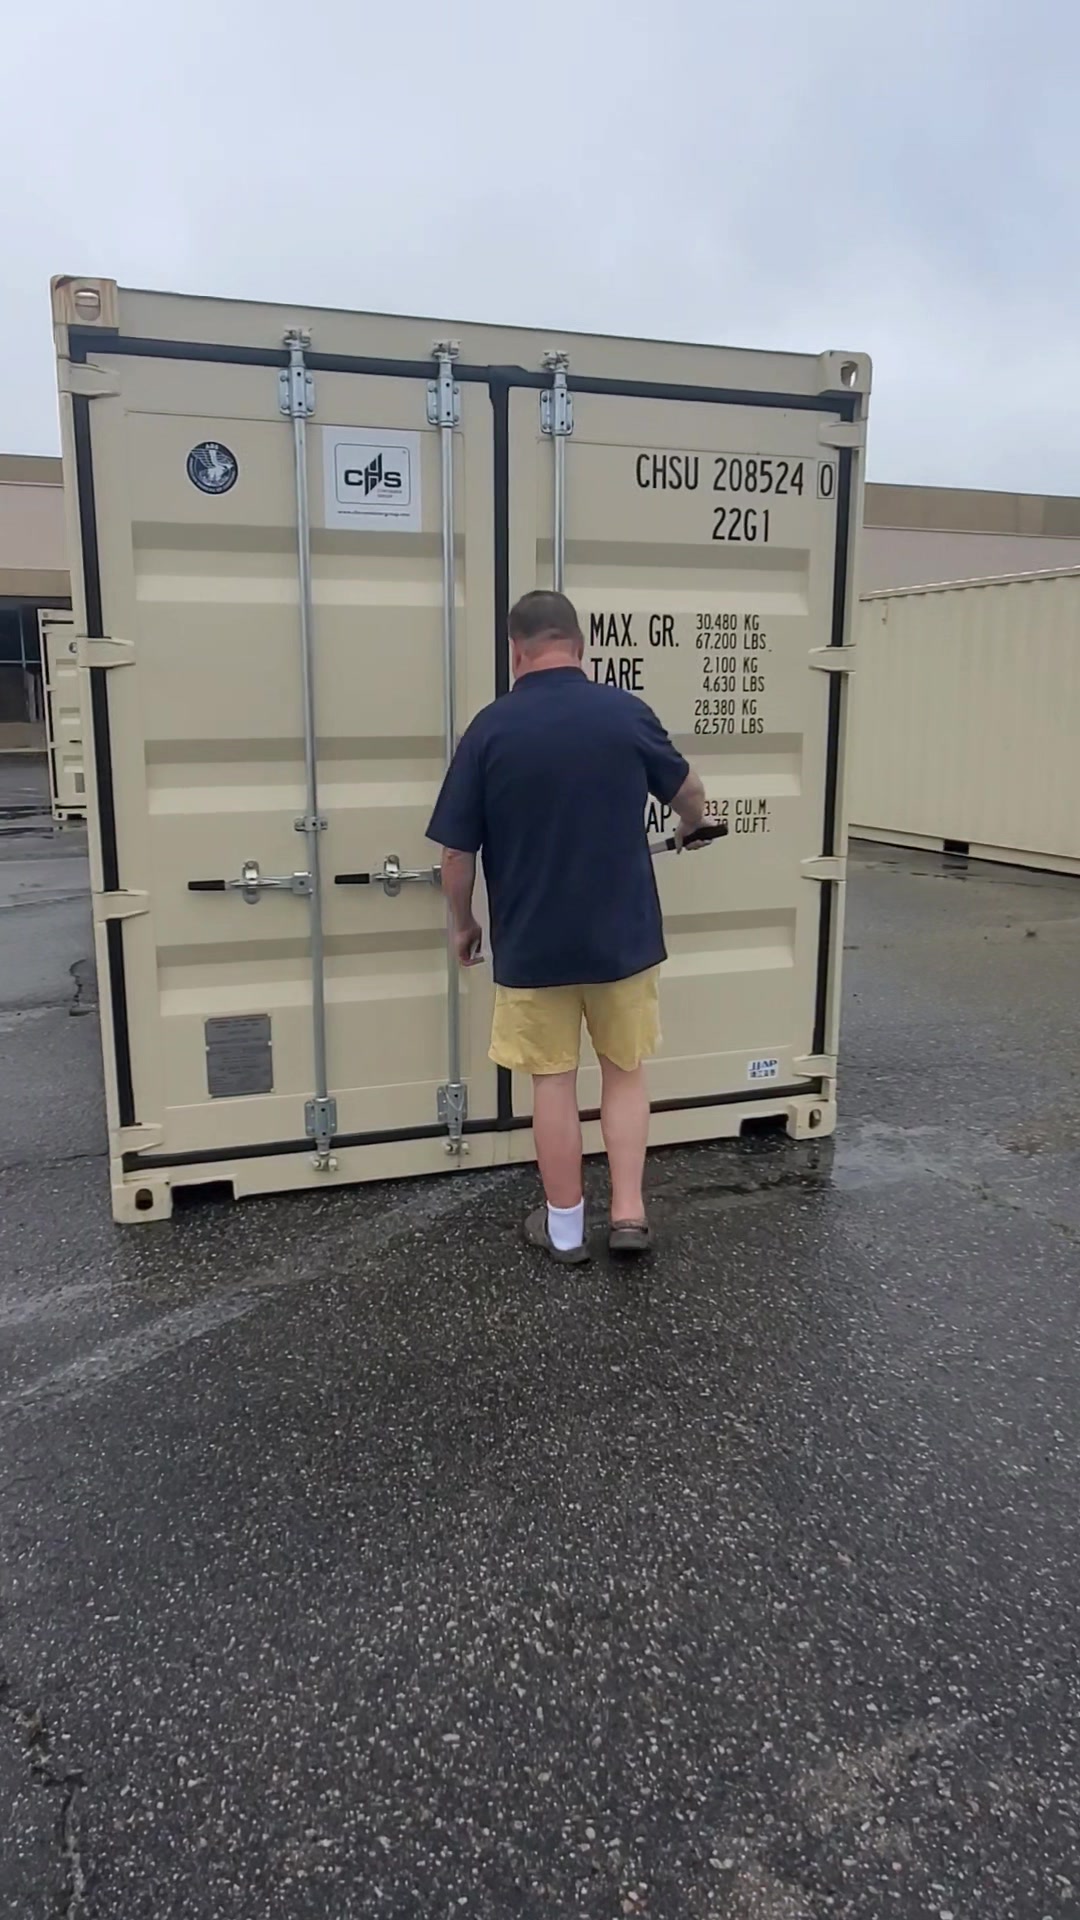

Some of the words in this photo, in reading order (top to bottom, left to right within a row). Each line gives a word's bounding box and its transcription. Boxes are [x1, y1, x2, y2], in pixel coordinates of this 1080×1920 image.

[344, 453, 402, 496] CHS
[636, 454, 699, 490] CHSU
[713, 457, 804, 496] 208524
[820, 464, 833, 497] 0
[712, 507, 769, 543] 22G1
[590, 612, 637, 647] MAX.
[649, 614, 679, 647] GR.
[696, 613, 737, 630] 30.480
[744, 614, 760, 630] KG
[696, 633, 737, 649] 67.200
[703, 656, 736, 673] 2.100
[743, 657, 758, 673] KG
[590, 657, 644, 691] TARE
[703, 676, 736, 692] 4.630
[742, 676, 765, 692] LBS
[695, 699, 735, 716] 28.380
[742, 699, 757, 715] KG
[694, 718, 735, 735] 62.570
[741, 718, 764, 734] LBS
[704, 801, 729, 816] 33.2
[736, 800, 771, 815] CU.M.
[646, 802, 676, 833] AP.
[735, 817, 770, 833] CU.FT.
